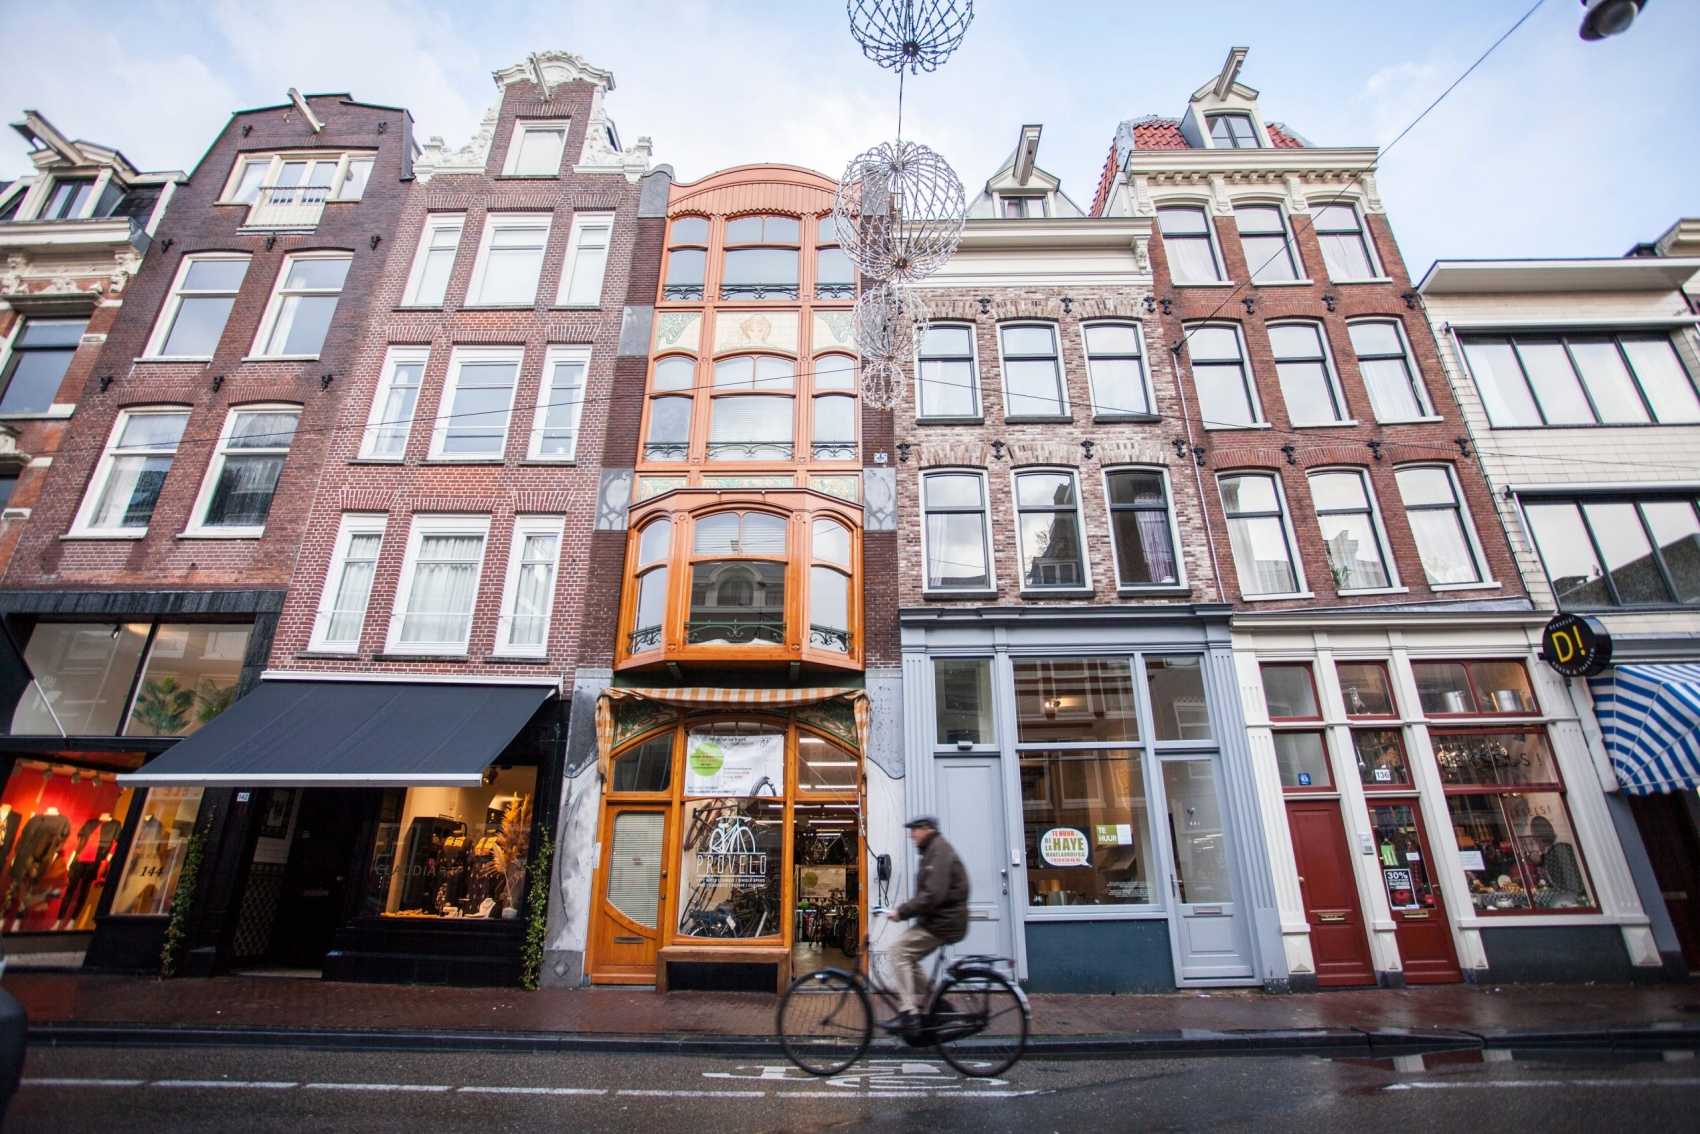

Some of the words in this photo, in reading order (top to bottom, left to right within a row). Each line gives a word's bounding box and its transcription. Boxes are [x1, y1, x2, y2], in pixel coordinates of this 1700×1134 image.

[1548, 617, 1575, 631] DEKSELS!
[1551, 625, 1586, 663] D!
[1551, 661, 1570, 675] KOKEN
[1052, 837, 1084, 851] HAYE
[140, 866, 164, 877] 144
[375, 864, 436, 877] CLAUDIA
[696, 854, 767, 875] PROVELO
[1387, 871, 1408, 880] 30%
